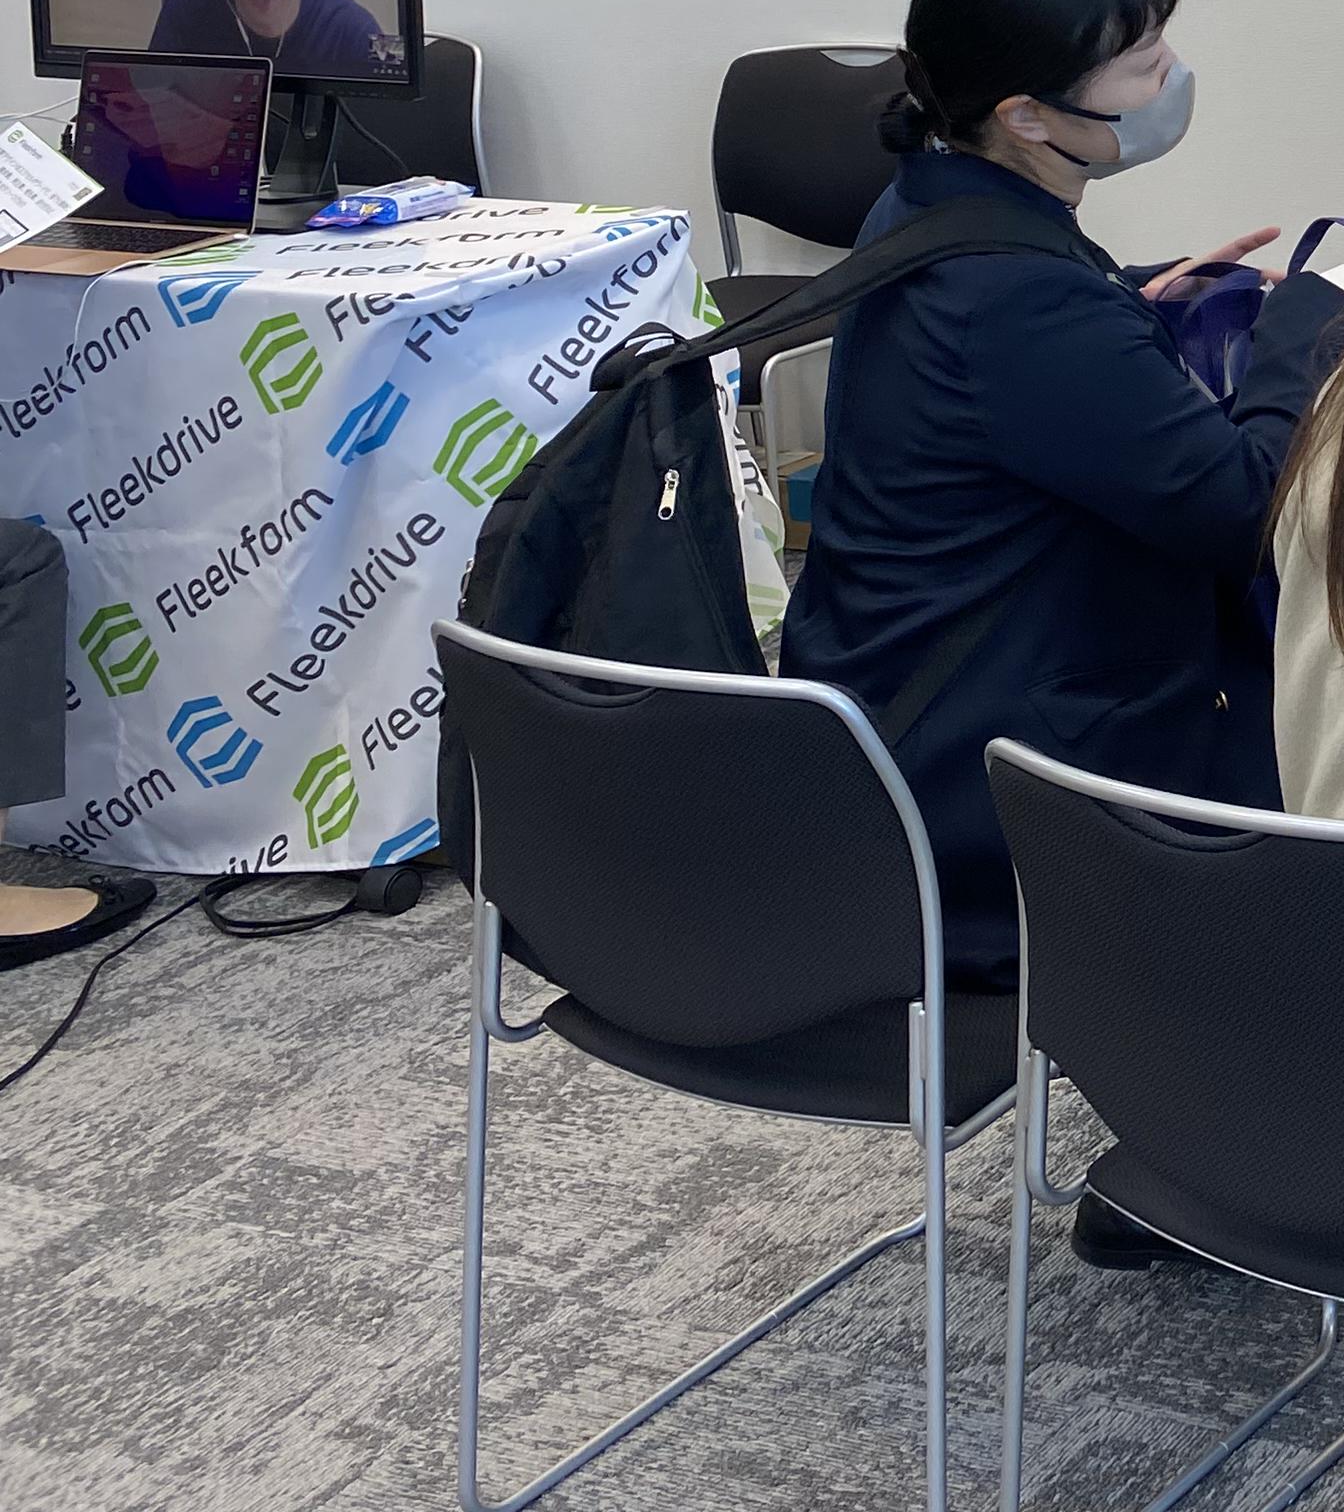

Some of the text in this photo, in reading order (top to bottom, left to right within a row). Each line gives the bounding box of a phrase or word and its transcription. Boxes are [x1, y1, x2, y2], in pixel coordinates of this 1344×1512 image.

[0, 306, 152, 439] leekform
[66, 395, 243, 545] Fleekdrive
[155, 487, 335, 634] Fleekform
[246, 512, 447, 718] Fleekdrive
[361, 666, 446, 772] Flee
